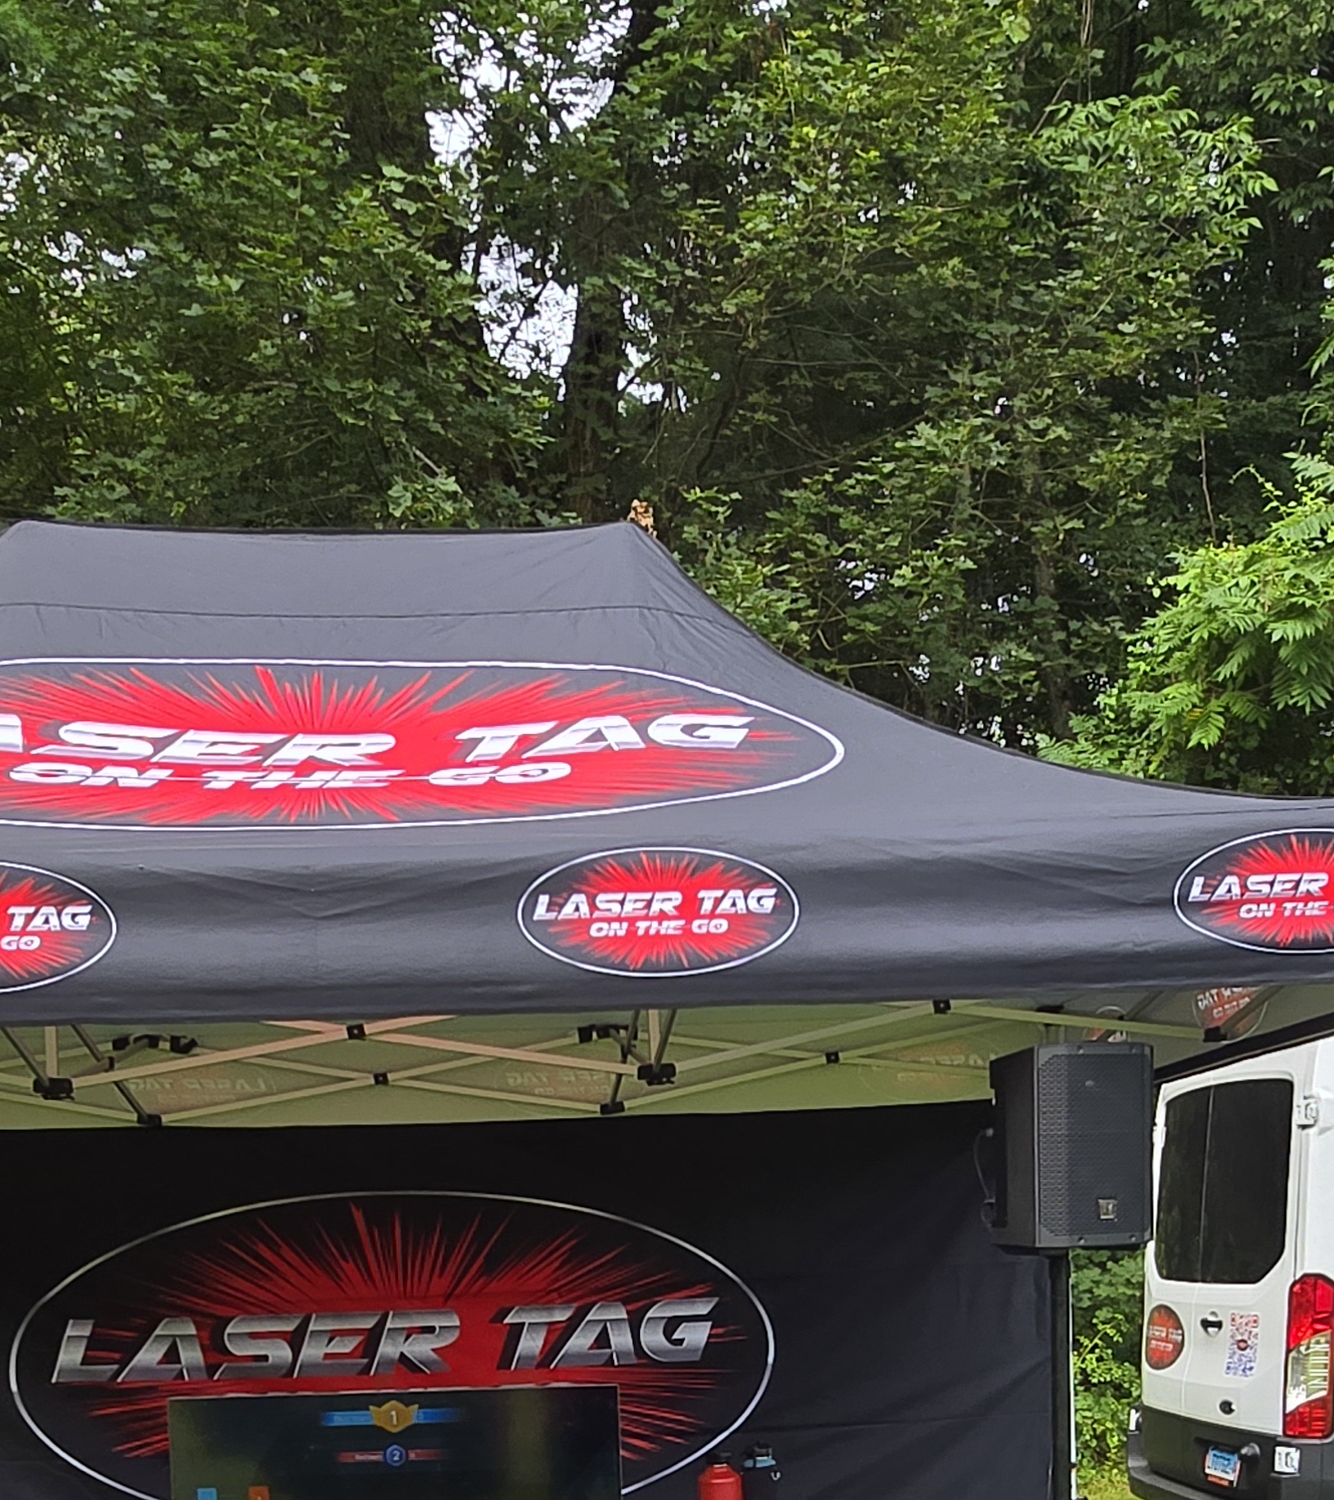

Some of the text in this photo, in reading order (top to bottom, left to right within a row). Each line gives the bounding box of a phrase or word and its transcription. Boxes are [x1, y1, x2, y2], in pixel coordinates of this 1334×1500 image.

[455, 712, 755, 762] TAG
[8, 760, 571, 789] ON THE GO
[1187, 872, 1329, 901] LASER
[533, 886, 777, 921] LASER TAG
[1239, 902, 1277, 919] ON
[1281, 901, 1327, 917] THE
[7, 904, 92, 931] TAG
[589, 918, 729, 939] ON THE GO
[0, 935, 41, 951] GO
[51, 1296, 720, 1384] LASER TAG
[390, 1410, 398, 1425] 1
[393, 1451, 400, 1461] 2
